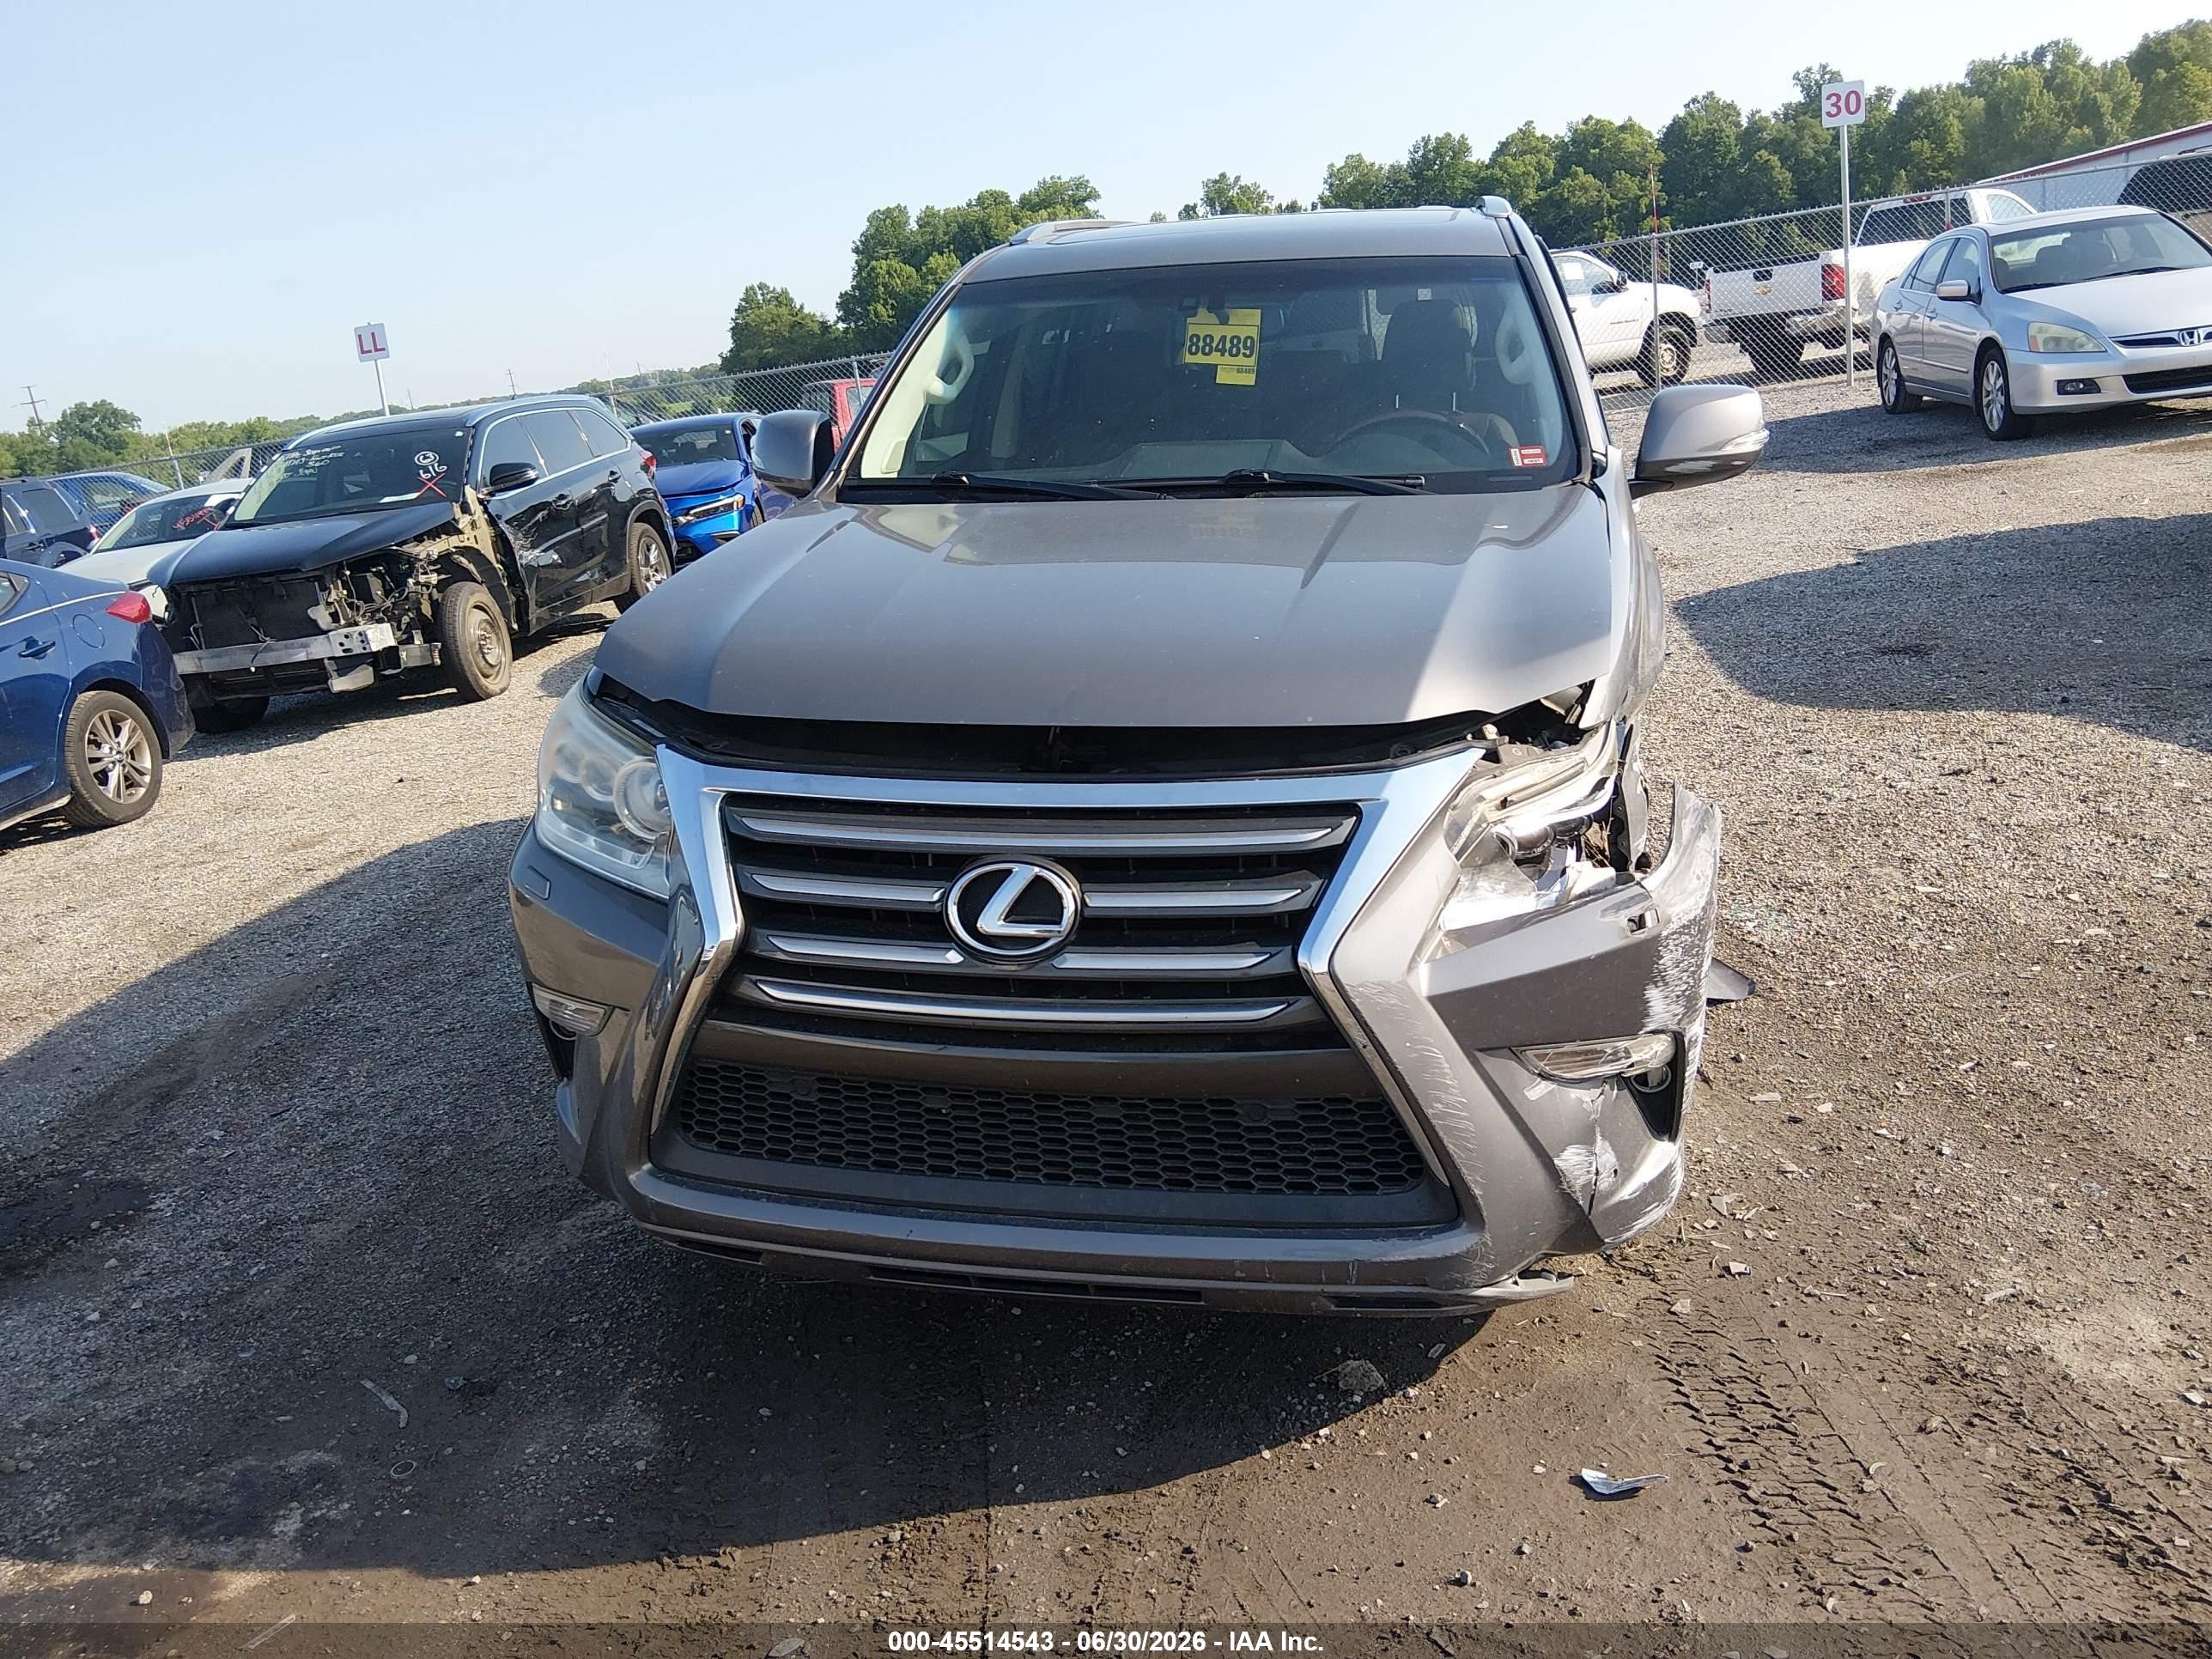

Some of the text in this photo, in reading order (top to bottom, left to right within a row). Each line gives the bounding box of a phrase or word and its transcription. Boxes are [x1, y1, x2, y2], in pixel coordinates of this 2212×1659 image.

[1826, 90, 1862, 118] 30
[357, 331, 386, 355] LL
[1188, 333, 1255, 358] 88489
[419, 463, 447, 479] 616
